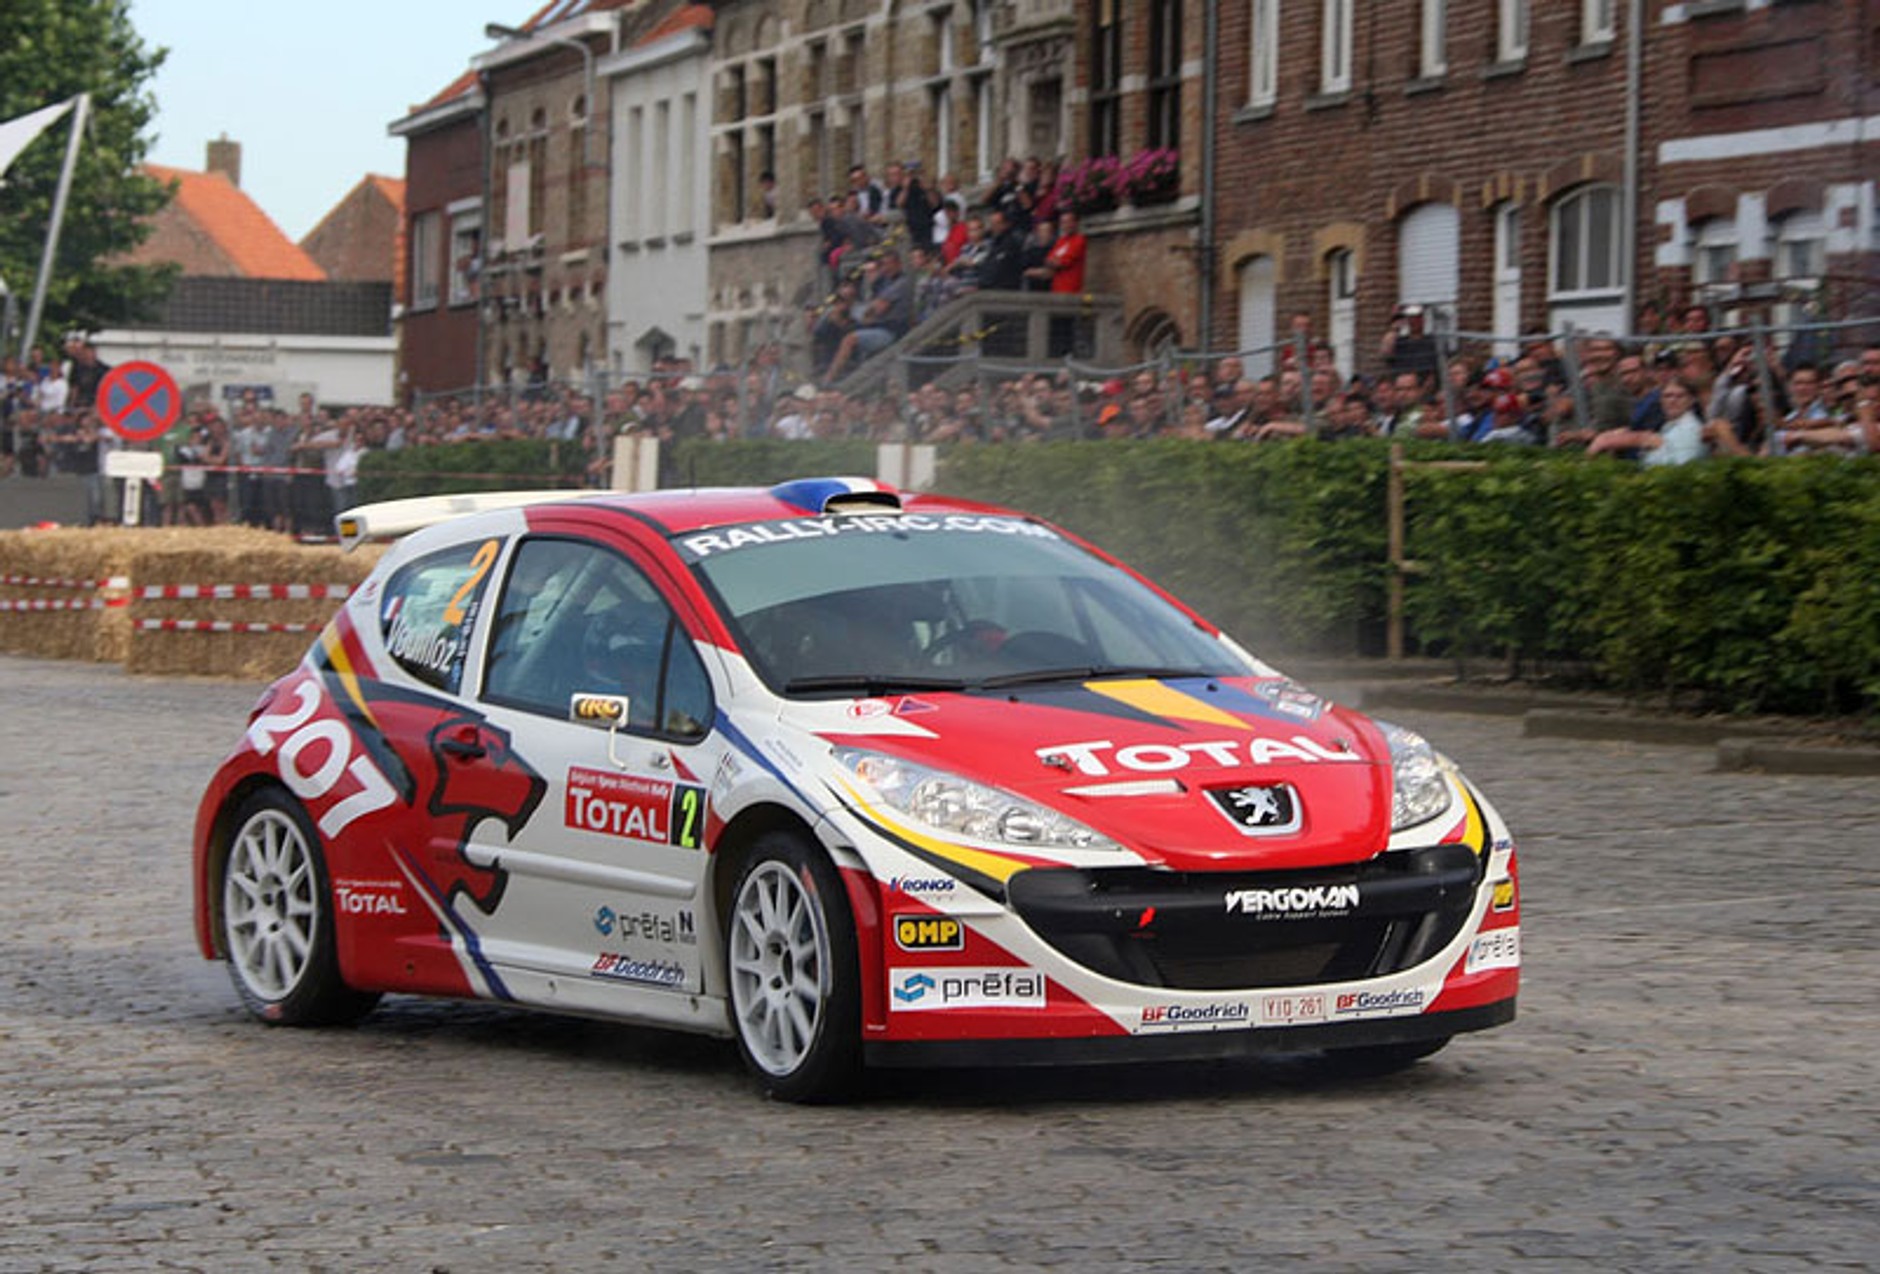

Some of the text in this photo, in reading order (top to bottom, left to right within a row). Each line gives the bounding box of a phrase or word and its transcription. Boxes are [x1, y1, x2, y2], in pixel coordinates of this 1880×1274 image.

[684, 514, 1060, 556] RALLY-IRC.COM
[442, 540, 499, 626] 2
[248, 680, 397, 839] 207
[1035, 736, 1361, 776] TOTAL
[570, 788, 667, 840] TOTAL
[681, 790, 698, 848] 2
[336, 889, 406, 914] TOTAL
[1225, 884, 1360, 913] VERGOKAN
[900, 921, 958, 944] OMP
[593, 952, 686, 983] BFGoodrich
[1142, 1002, 1249, 1022] BFGoodrich
[1336, 988, 1424, 1008] BFGoodrich
